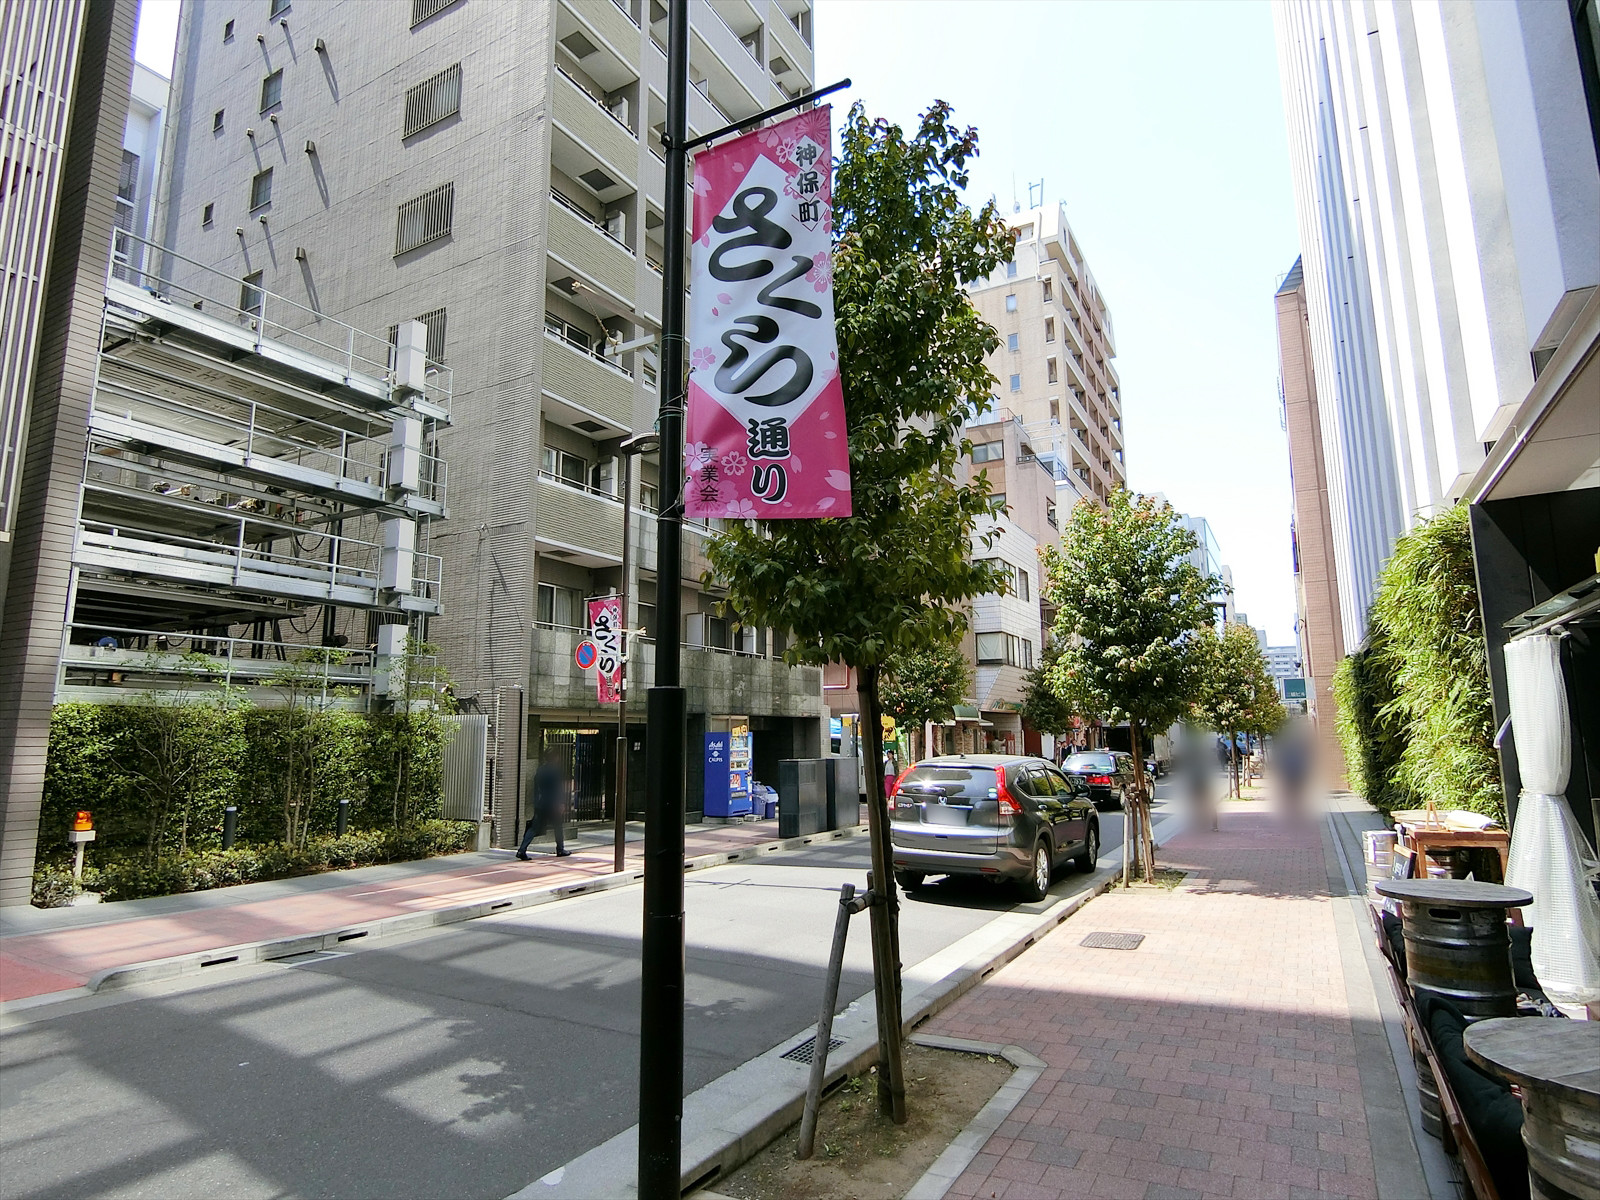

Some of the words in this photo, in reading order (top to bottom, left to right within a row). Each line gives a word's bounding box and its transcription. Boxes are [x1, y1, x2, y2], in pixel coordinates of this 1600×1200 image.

[795, 143, 820, 223] 神保町
[699, 445, 720, 503] 実業会
